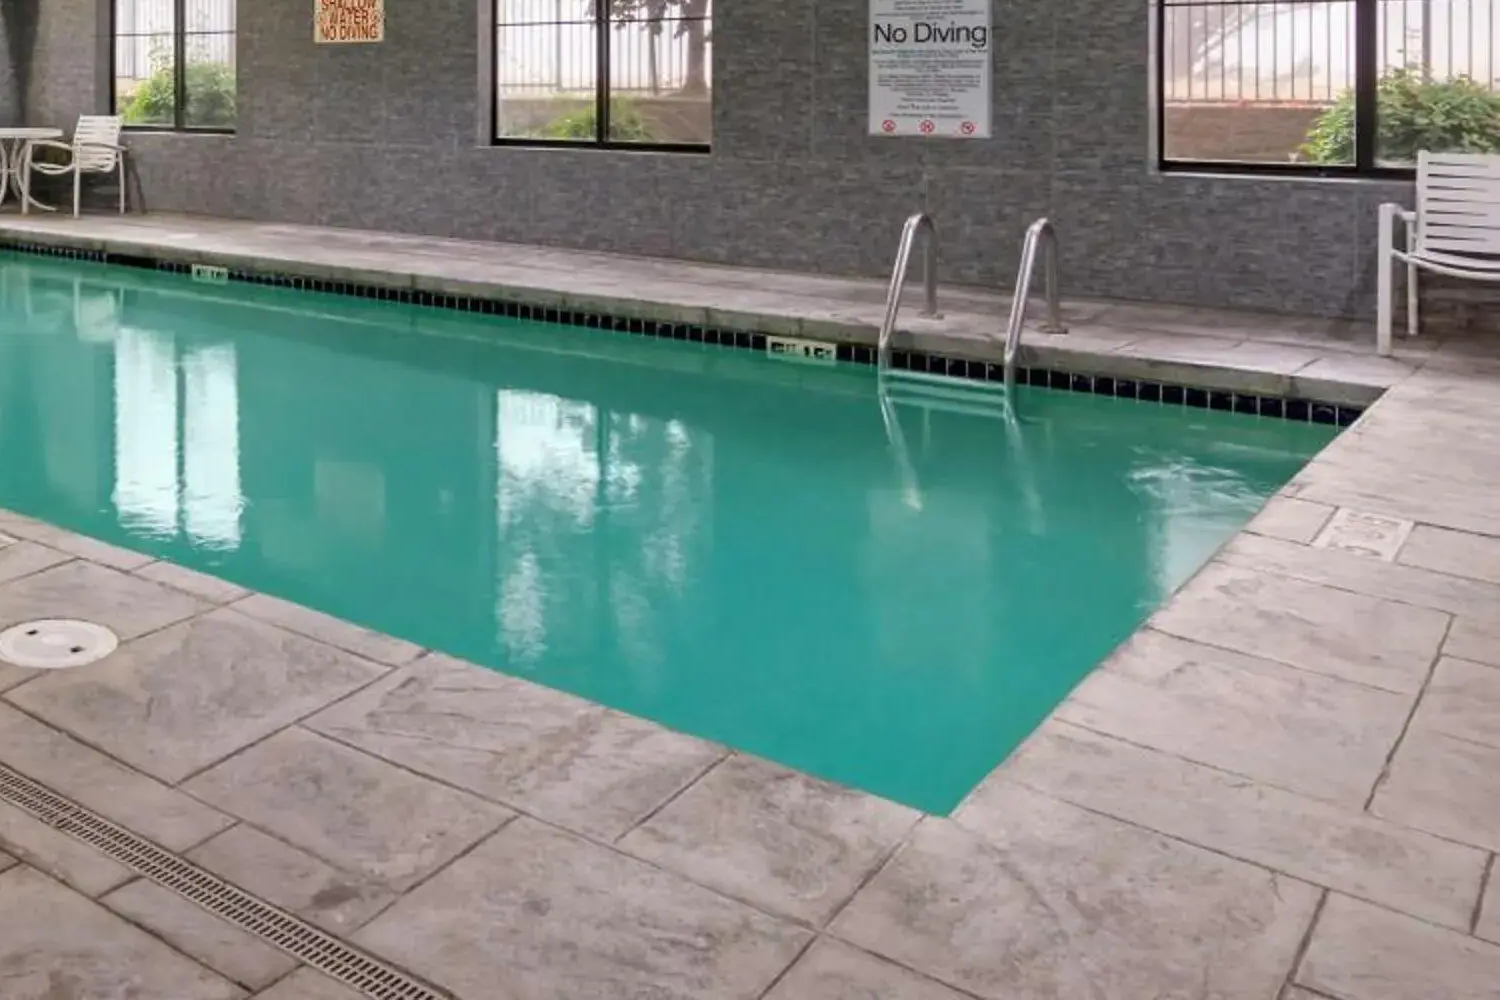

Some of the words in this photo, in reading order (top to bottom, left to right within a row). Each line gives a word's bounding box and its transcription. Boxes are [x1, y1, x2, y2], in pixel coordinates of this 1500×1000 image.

[329, 7, 369, 24] WATER
[874, 23, 907, 44] No
[914, 21, 987, 48] Diving
